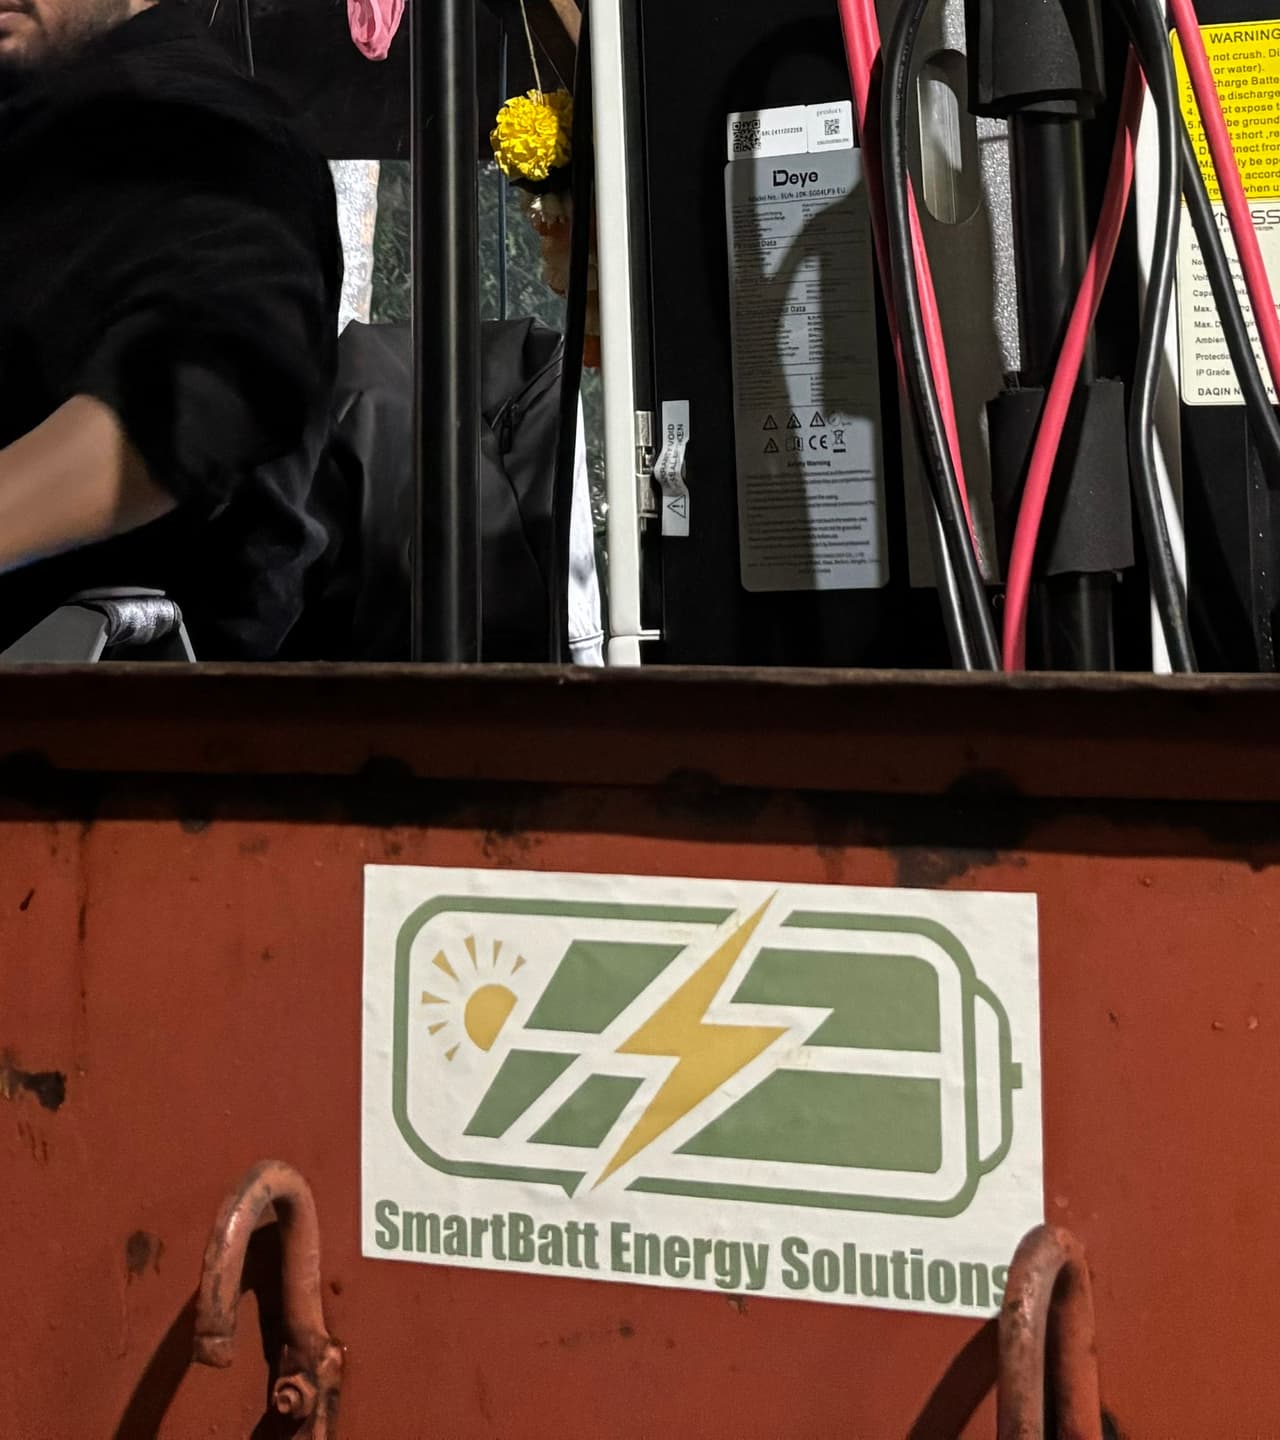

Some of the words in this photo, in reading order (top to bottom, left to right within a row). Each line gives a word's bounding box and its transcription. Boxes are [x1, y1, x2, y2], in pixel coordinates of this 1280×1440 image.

[1212, 51, 1230, 61] not
[1231, 49, 1266, 61] crush.
[1196, 386, 1231, 396] DAQIN
[373, 1199, 600, 1270] SmartBatt
[610, 1220, 771, 1291] Energy
[780, 1235, 1014, 1309] Solutions
